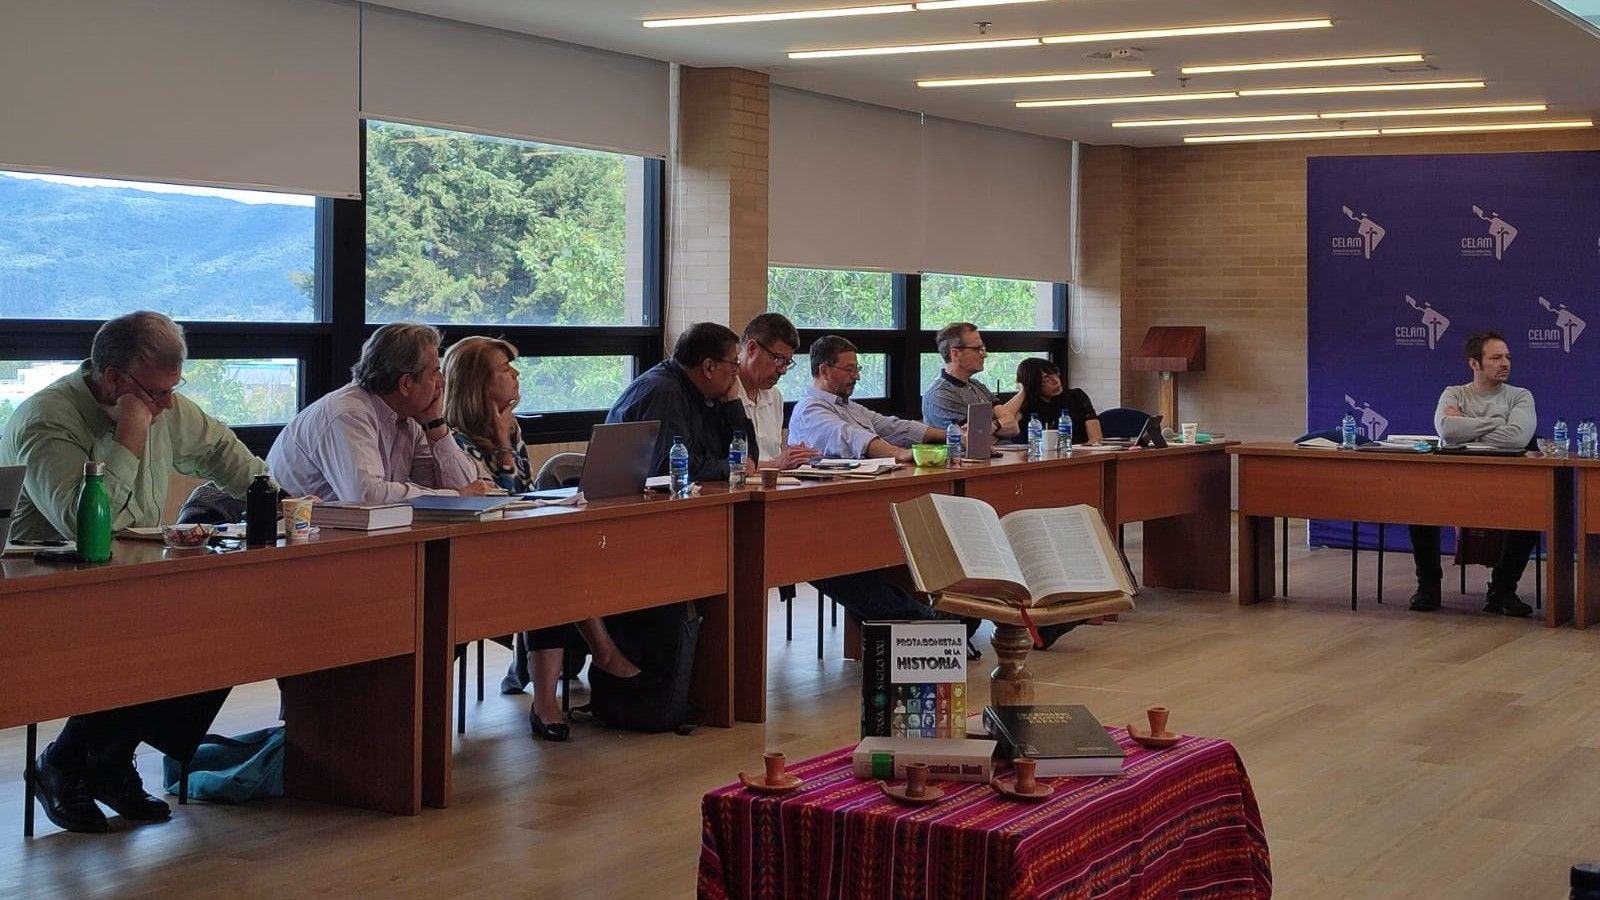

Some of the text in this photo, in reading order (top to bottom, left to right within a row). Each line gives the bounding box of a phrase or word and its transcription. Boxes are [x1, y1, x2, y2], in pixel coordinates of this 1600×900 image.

[1332, 237, 1362, 248] CELAM
[1461, 237, 1493, 249] CELAM
[1395, 326, 1426, 338] CELAM
[1528, 329, 1560, 341] CELAM
[896, 637, 962, 647] PROTAGONISTAS
[896, 656, 962, 670] HISTORIA
